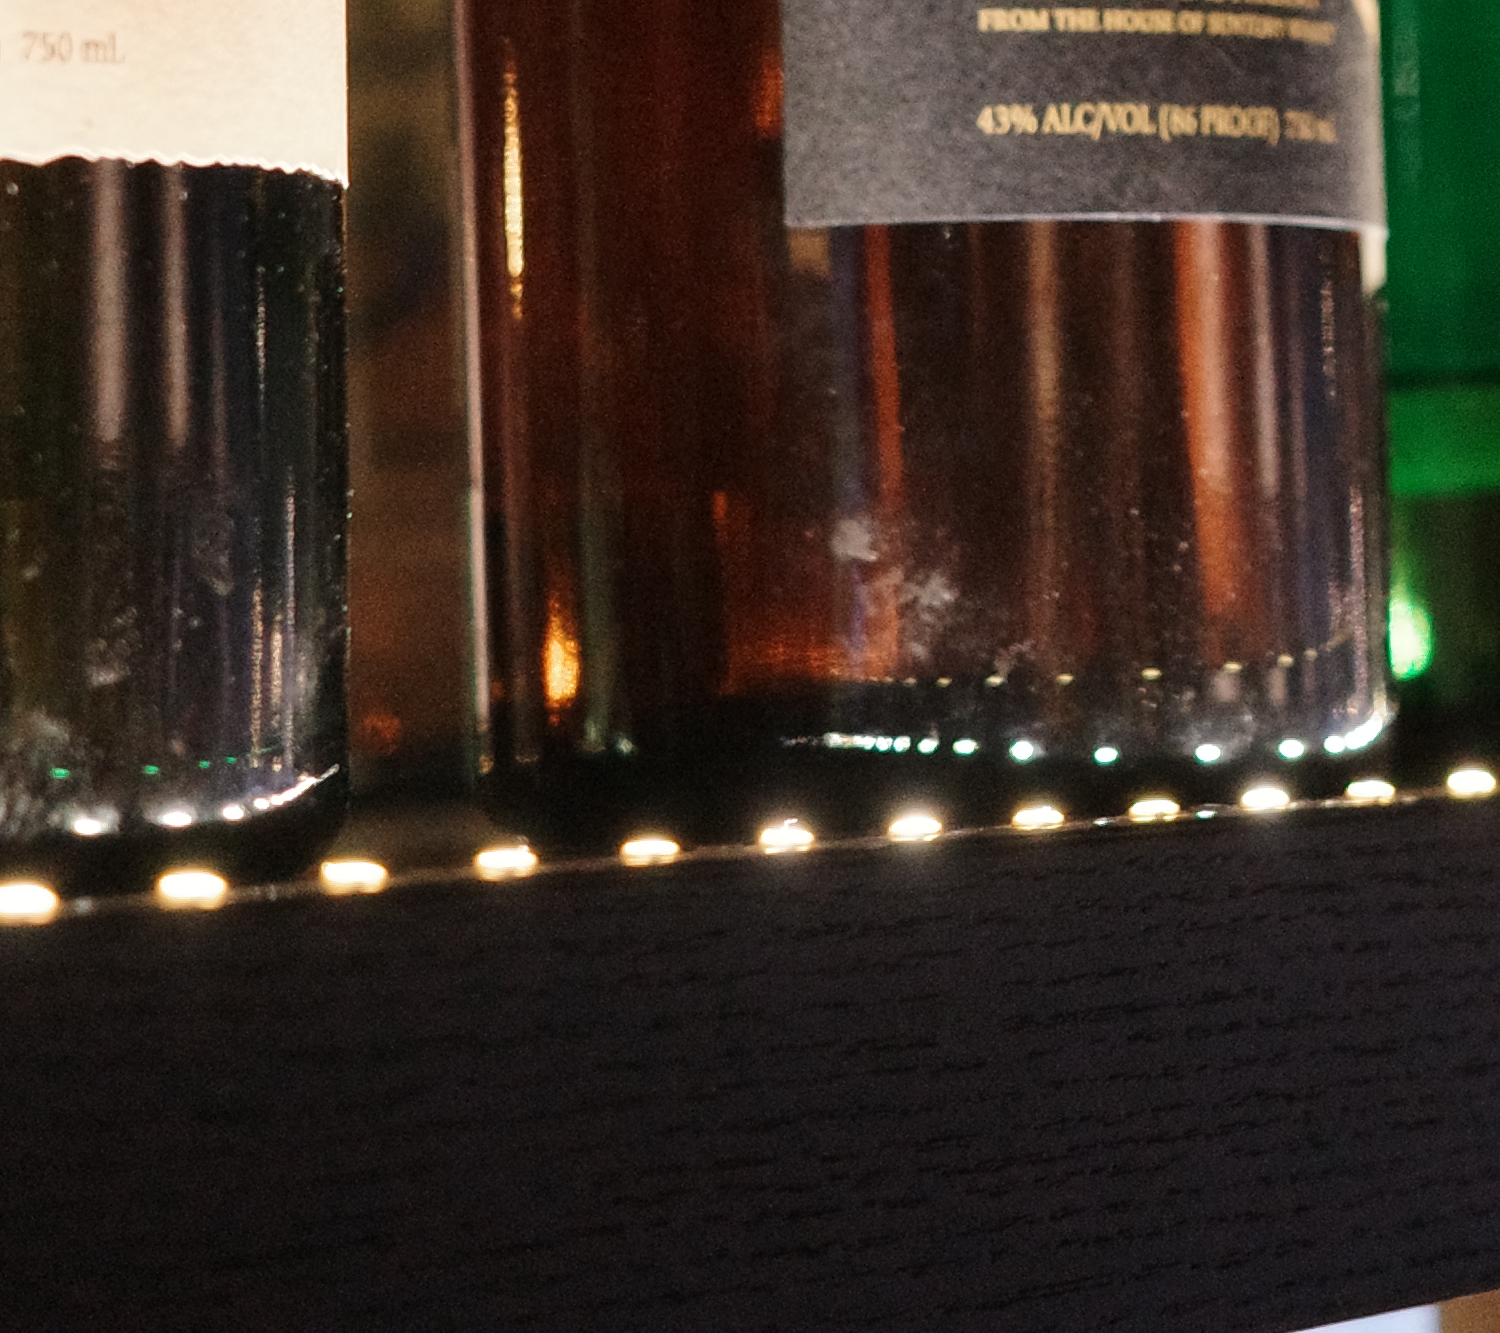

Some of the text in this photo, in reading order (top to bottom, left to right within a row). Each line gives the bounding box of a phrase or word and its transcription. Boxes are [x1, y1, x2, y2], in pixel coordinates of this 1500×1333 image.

[976, 7, 1050, 33] FROM
[1052, 8, 1101, 33] THE
[20, 29, 75, 65] 750
[975, 103, 1038, 137] 43%
[1040, 101, 1156, 143] ALC/VOL
